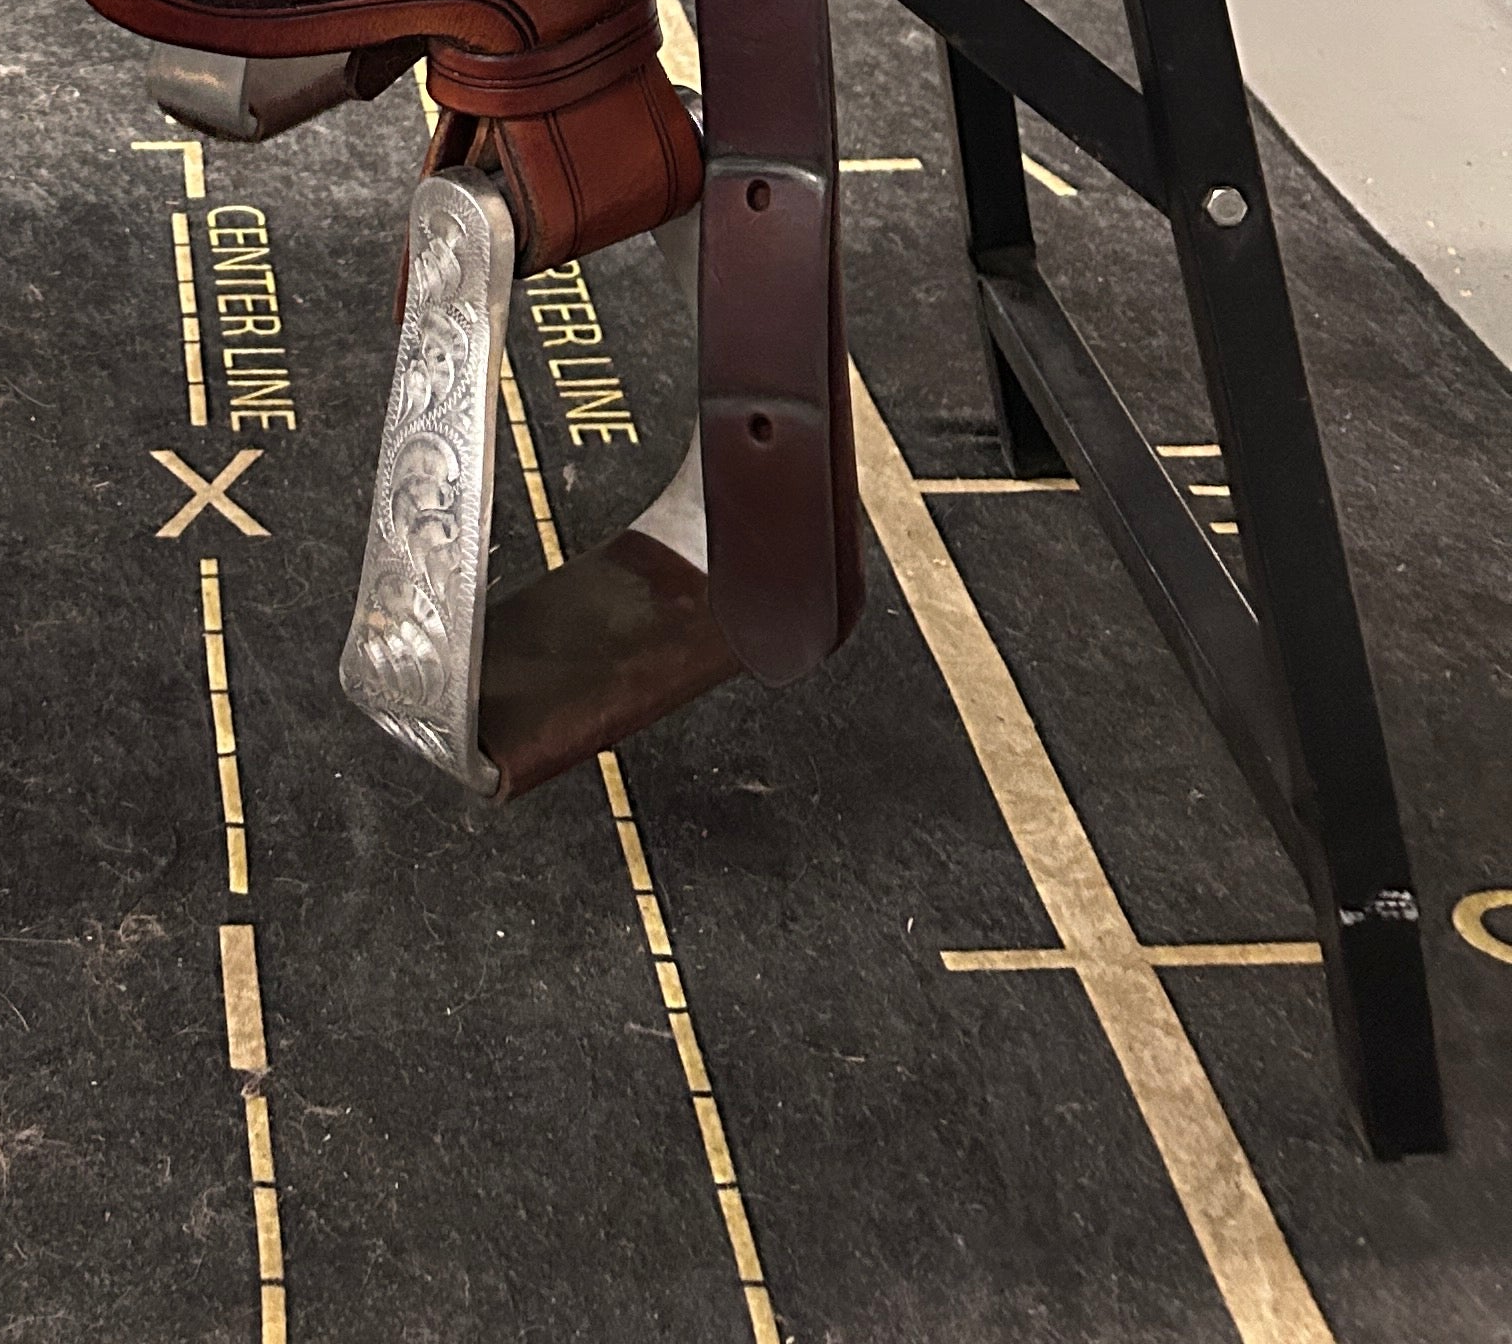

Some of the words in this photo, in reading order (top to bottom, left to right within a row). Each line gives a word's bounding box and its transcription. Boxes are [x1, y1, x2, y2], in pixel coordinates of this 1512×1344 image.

[207, 205, 282, 336] CENTER
[223, 348, 296, 432] LINE
[548, 356, 639, 447] LINE
[149, 448, 272, 538] X
